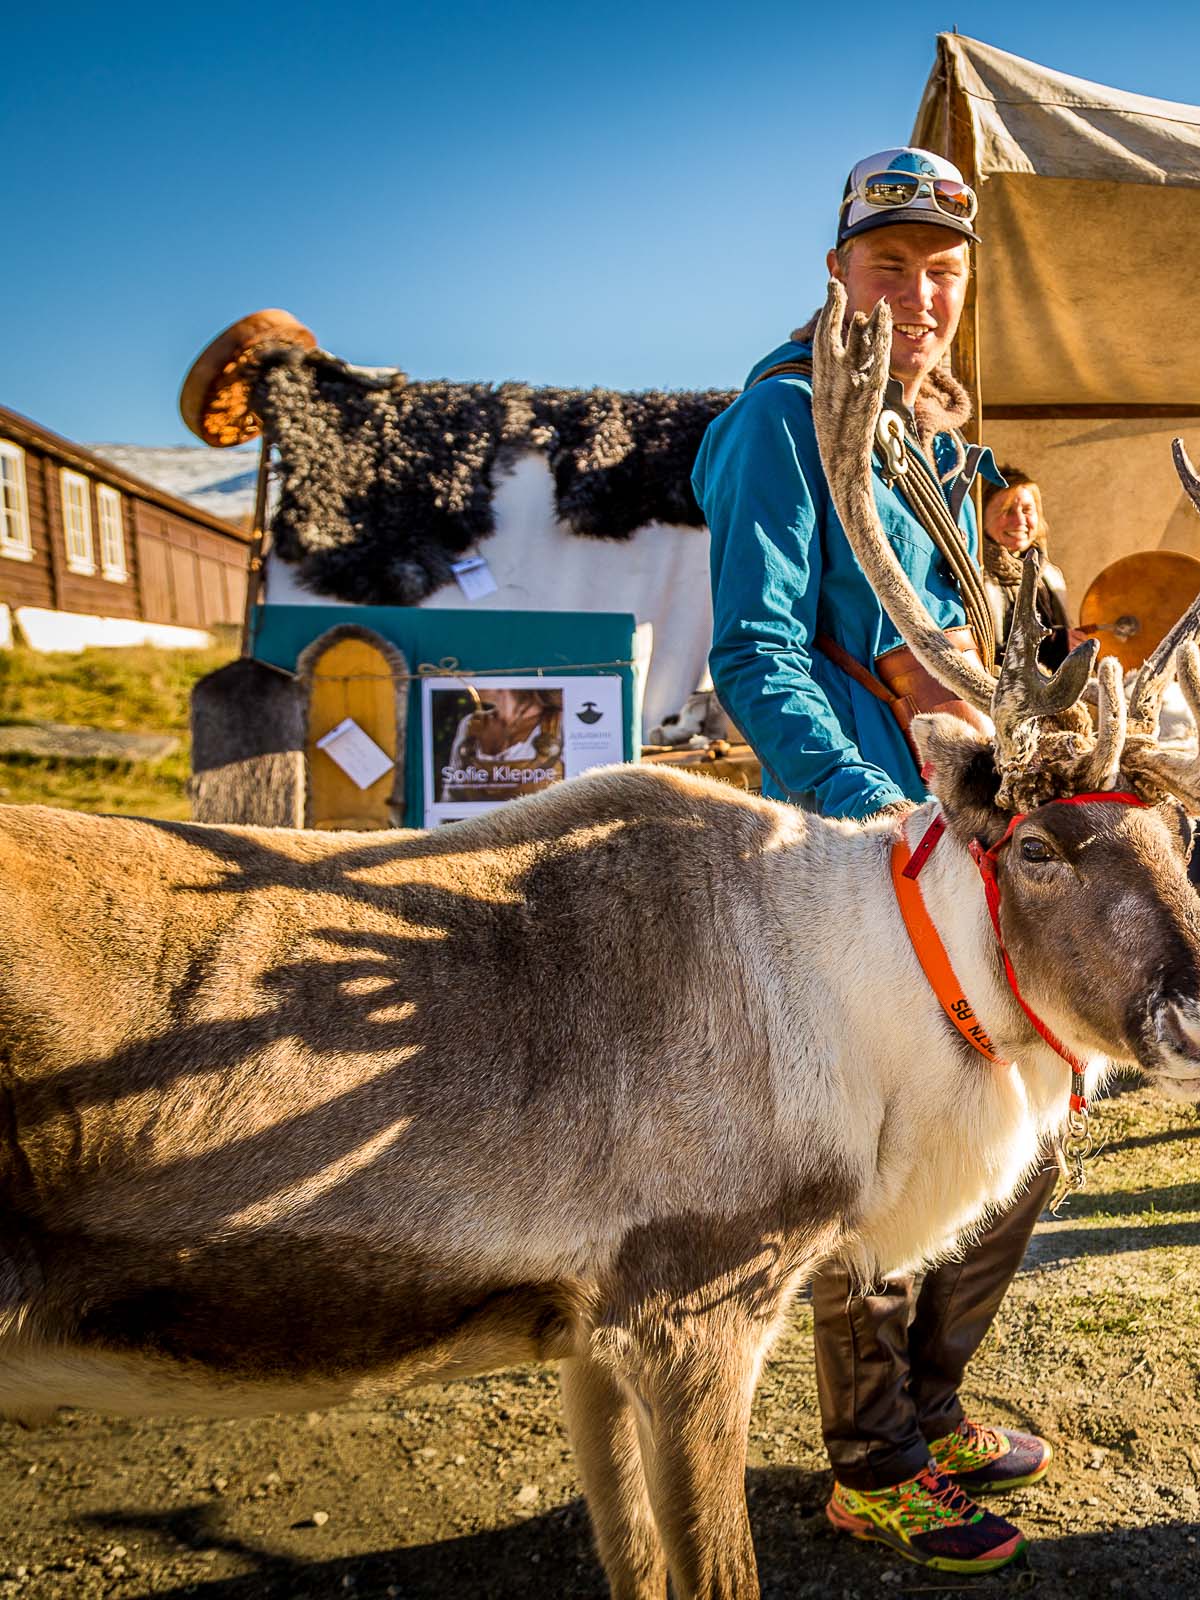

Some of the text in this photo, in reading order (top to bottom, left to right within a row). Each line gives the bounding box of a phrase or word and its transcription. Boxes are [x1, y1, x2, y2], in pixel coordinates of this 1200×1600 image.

[441, 765, 557, 785] Sofie Kleppe
[950, 999, 975, 1021] AS
